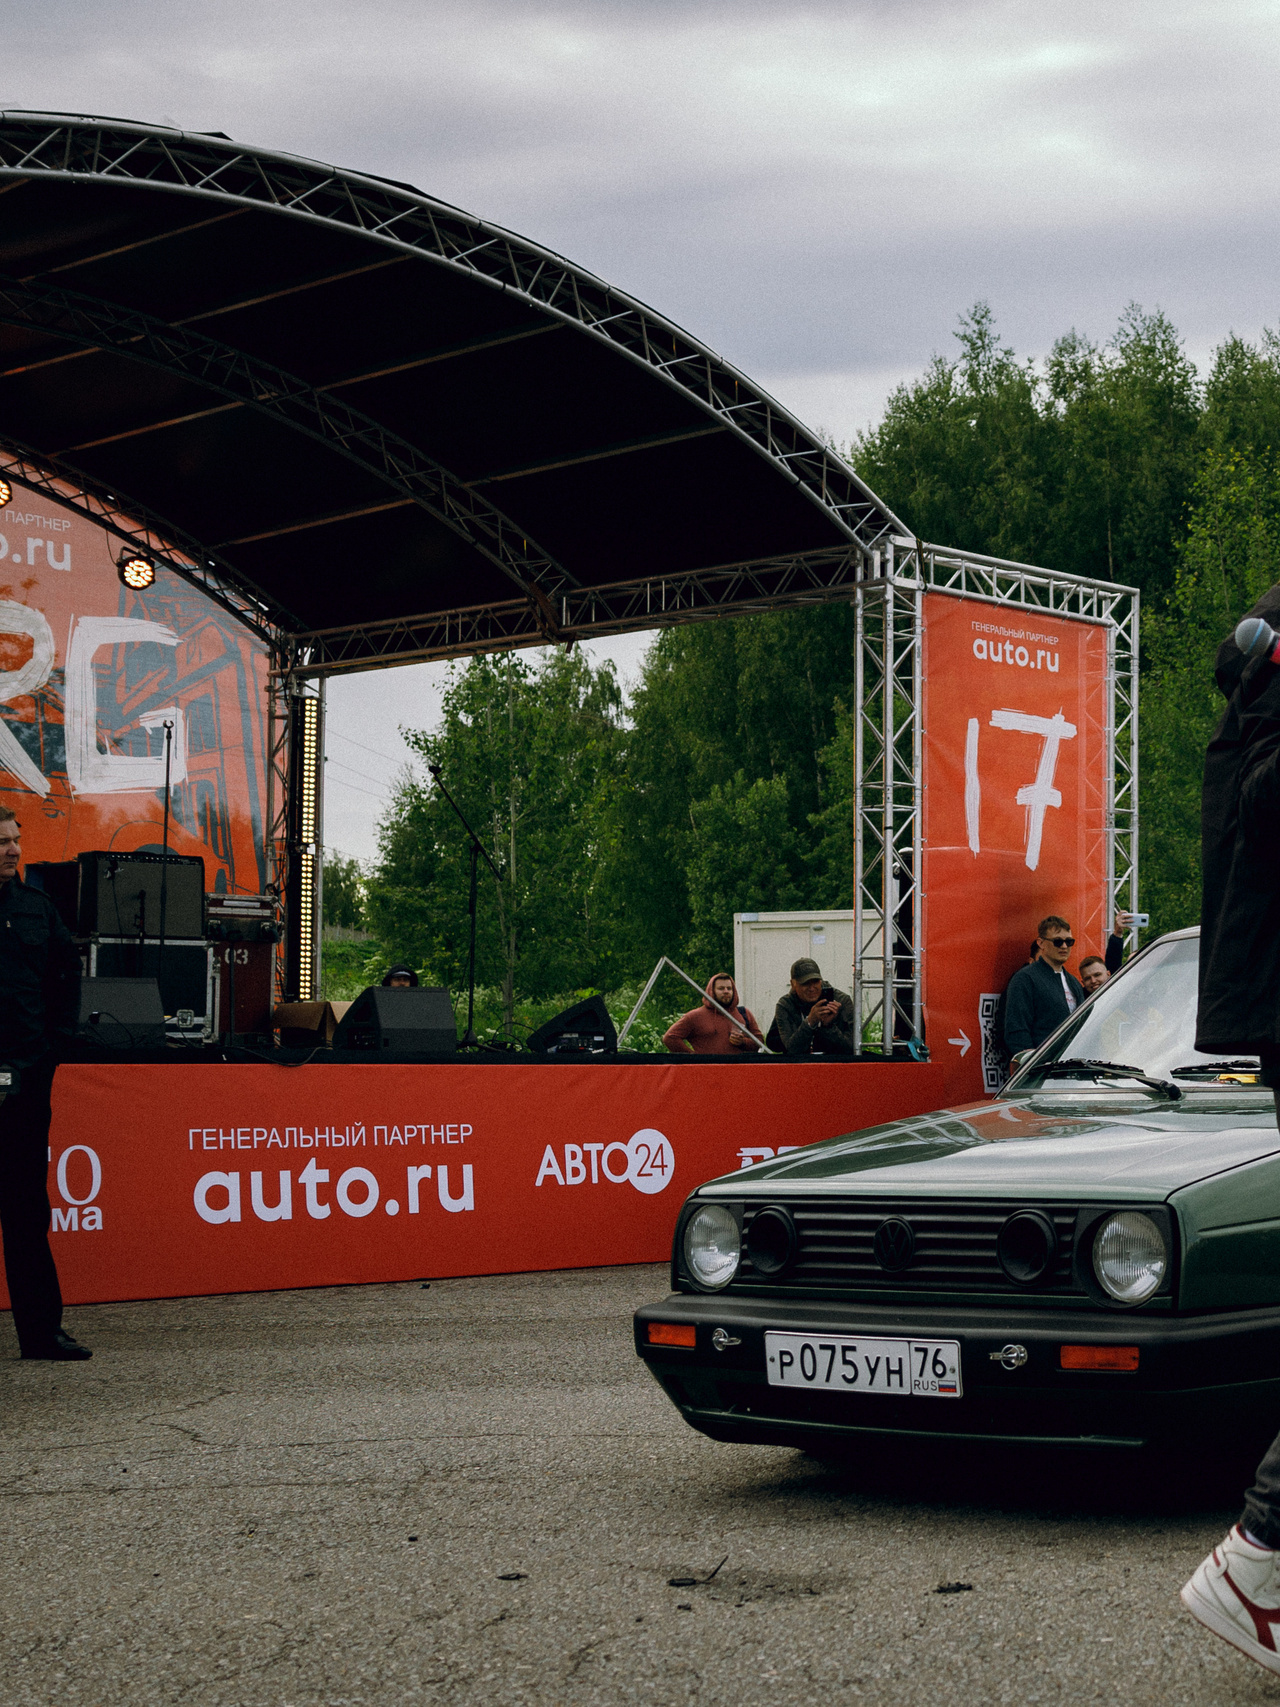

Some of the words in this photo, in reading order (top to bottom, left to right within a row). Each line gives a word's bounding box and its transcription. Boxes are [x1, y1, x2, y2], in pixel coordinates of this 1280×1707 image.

[5, 510, 71, 532] ПАРТНЕР
[971, 620, 1025, 639] ГЕНЕРАЛЬНЫЙ
[1026, 631, 1059, 646] ПАРТНЕР
[972, 638, 1060, 673] auto.ru
[963, 706, 1078, 872] 17
[188, 1122, 367, 1150] ГЕНЕРАЛЬНЫЙ
[373, 1123, 474, 1146] ПАРТНЕР
[193, 1157, 476, 1225] auto.ru
[914, 1346, 947, 1379] 76
[913, 1379, 938, 1392] RUS
